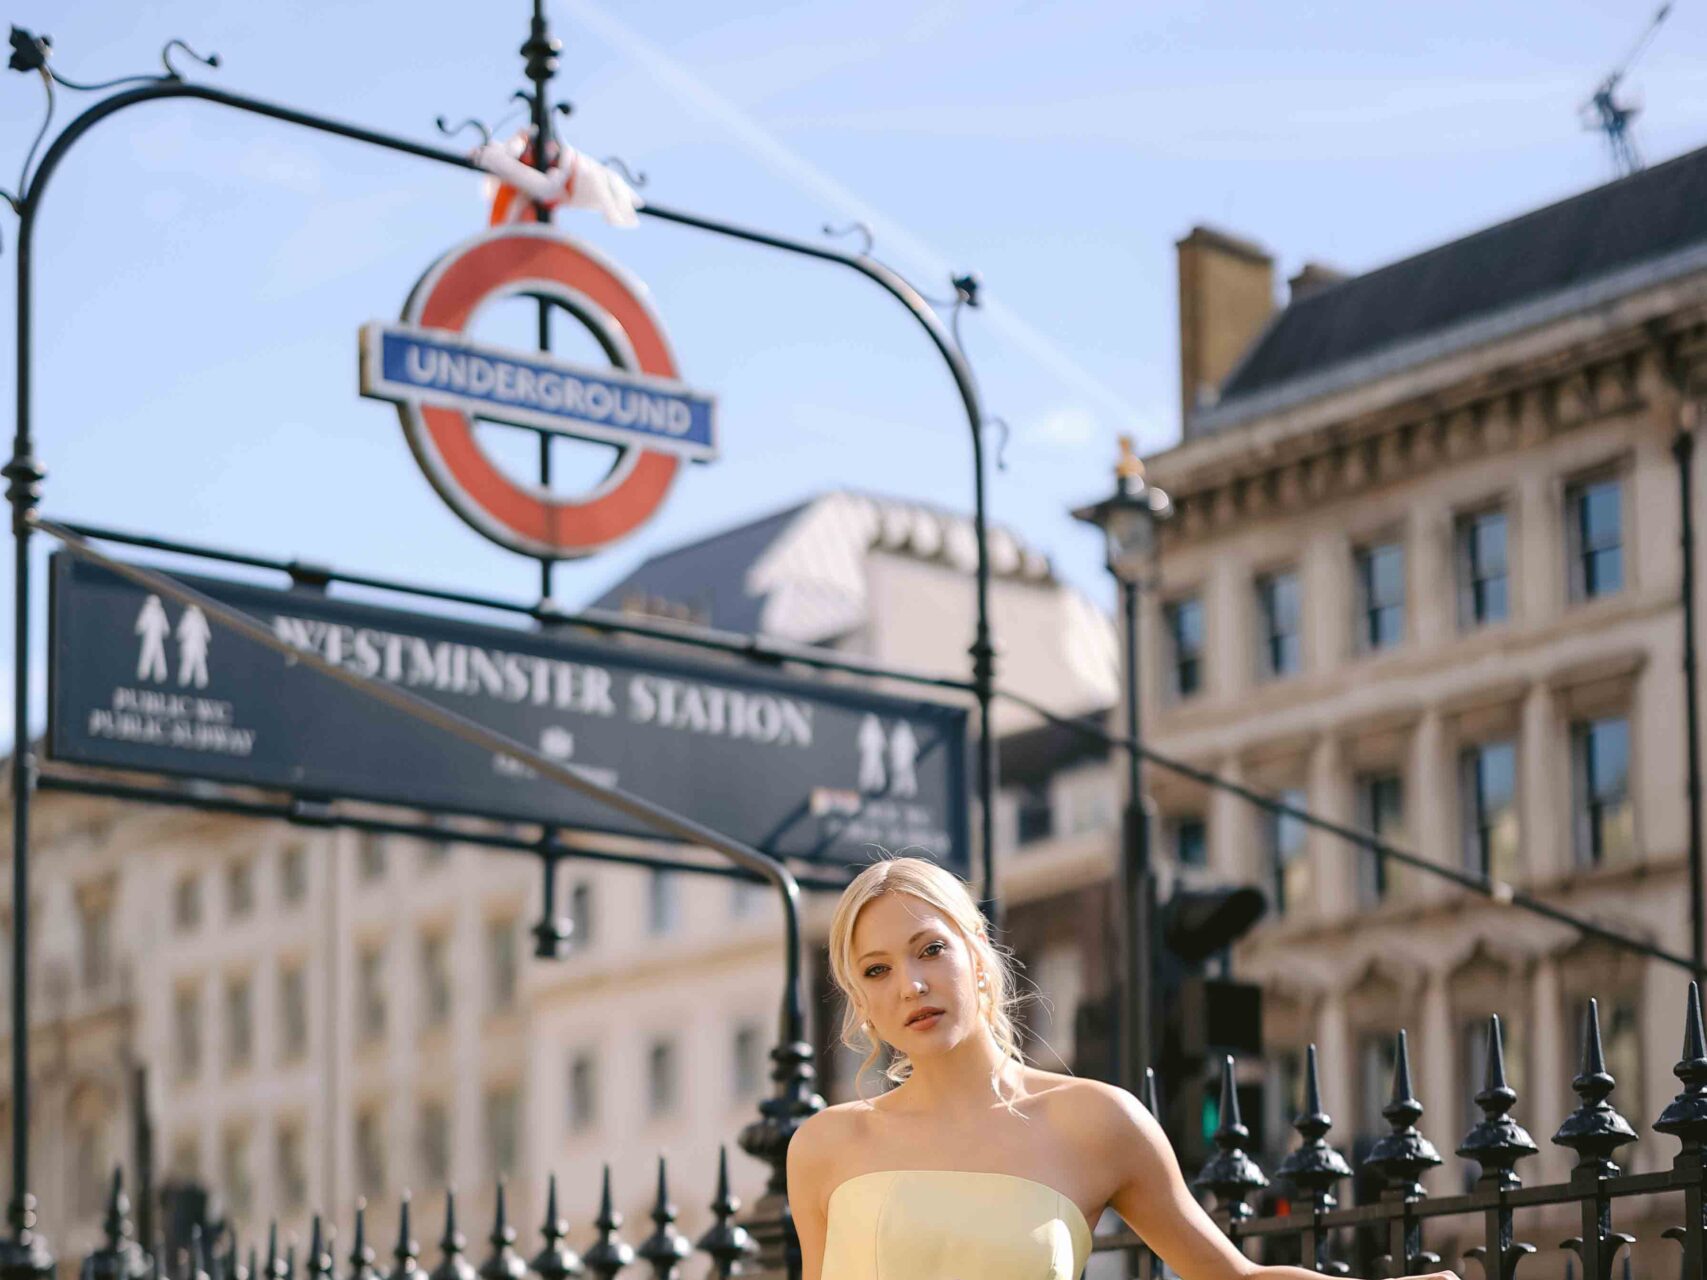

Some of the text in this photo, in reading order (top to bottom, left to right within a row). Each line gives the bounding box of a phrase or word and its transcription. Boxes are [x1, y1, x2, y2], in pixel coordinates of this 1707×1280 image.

[405, 344, 692, 435] UNDERGROUND
[272, 616, 814, 746] WESTMINSTER STATION
